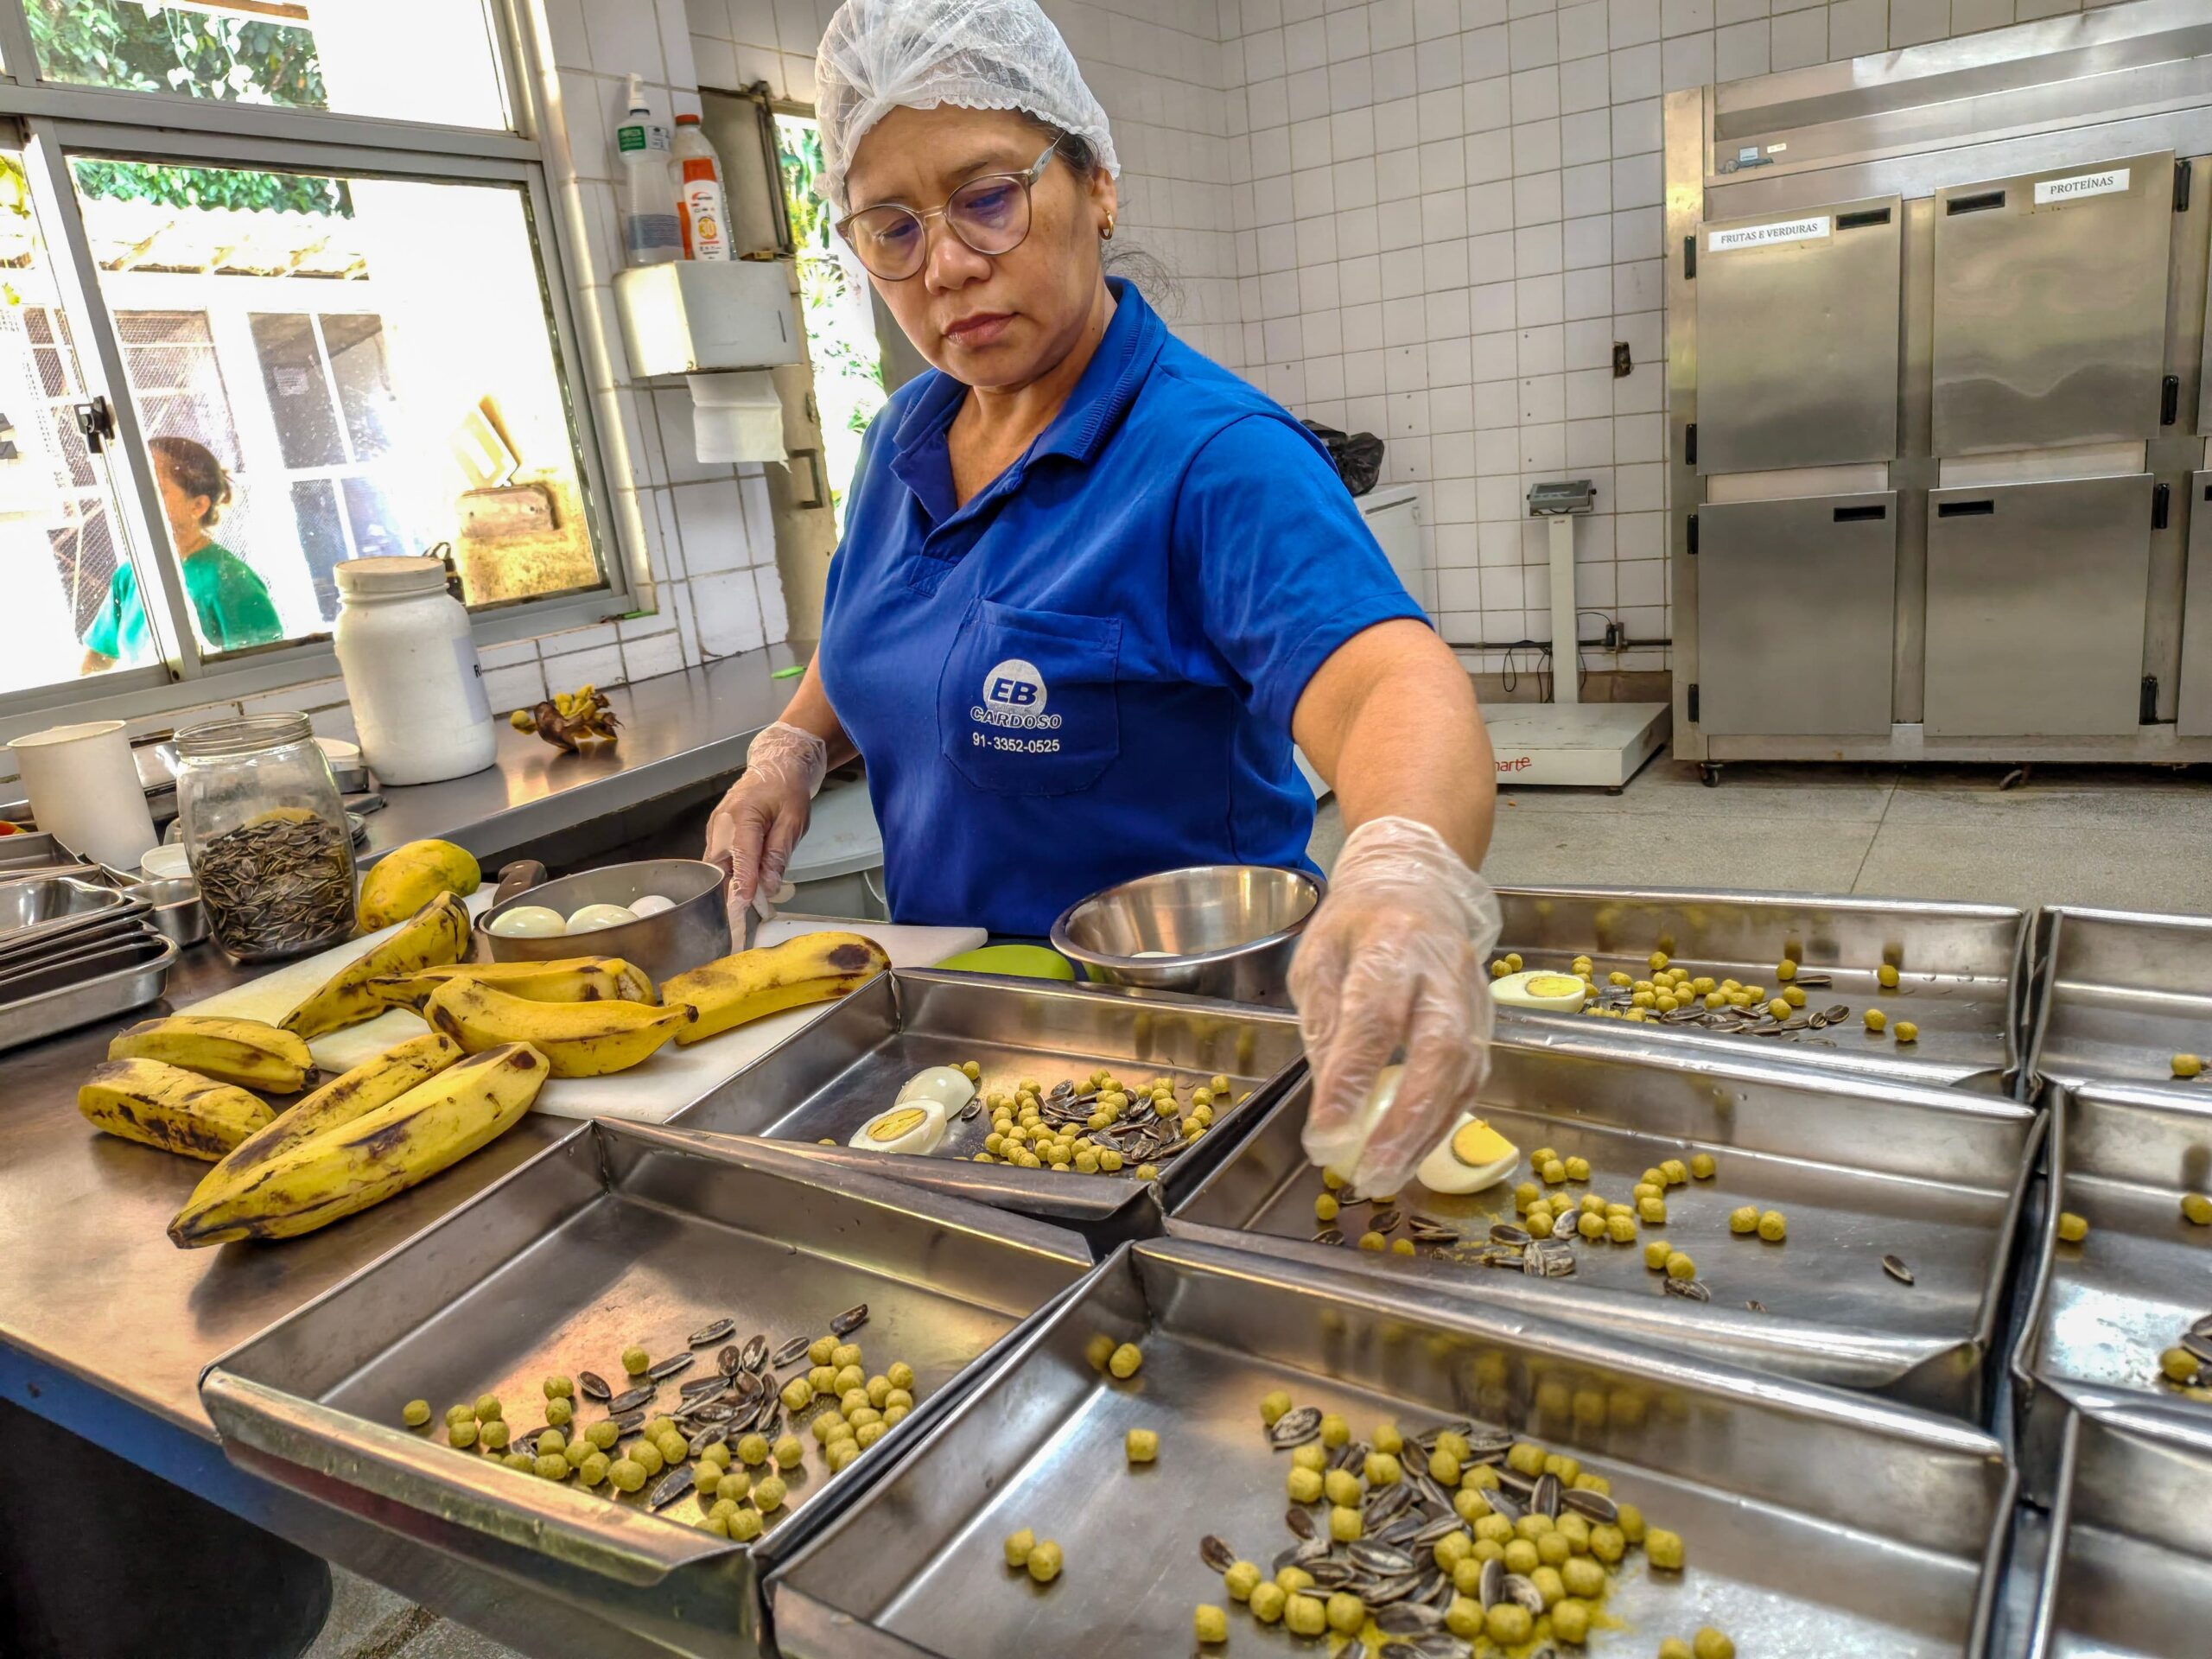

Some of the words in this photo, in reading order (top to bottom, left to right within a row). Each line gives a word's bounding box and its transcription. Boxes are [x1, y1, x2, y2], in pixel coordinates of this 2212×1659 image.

[2050, 176, 2114, 194] PROTEÍNAS
[1720, 231, 1758, 244] FRUTAS
[1758, 229, 1765, 239] E
[1767, 223, 1818, 238] VERDURAS
[988, 677, 1038, 706] EB
[970, 706, 1062, 729] CARDOSO
